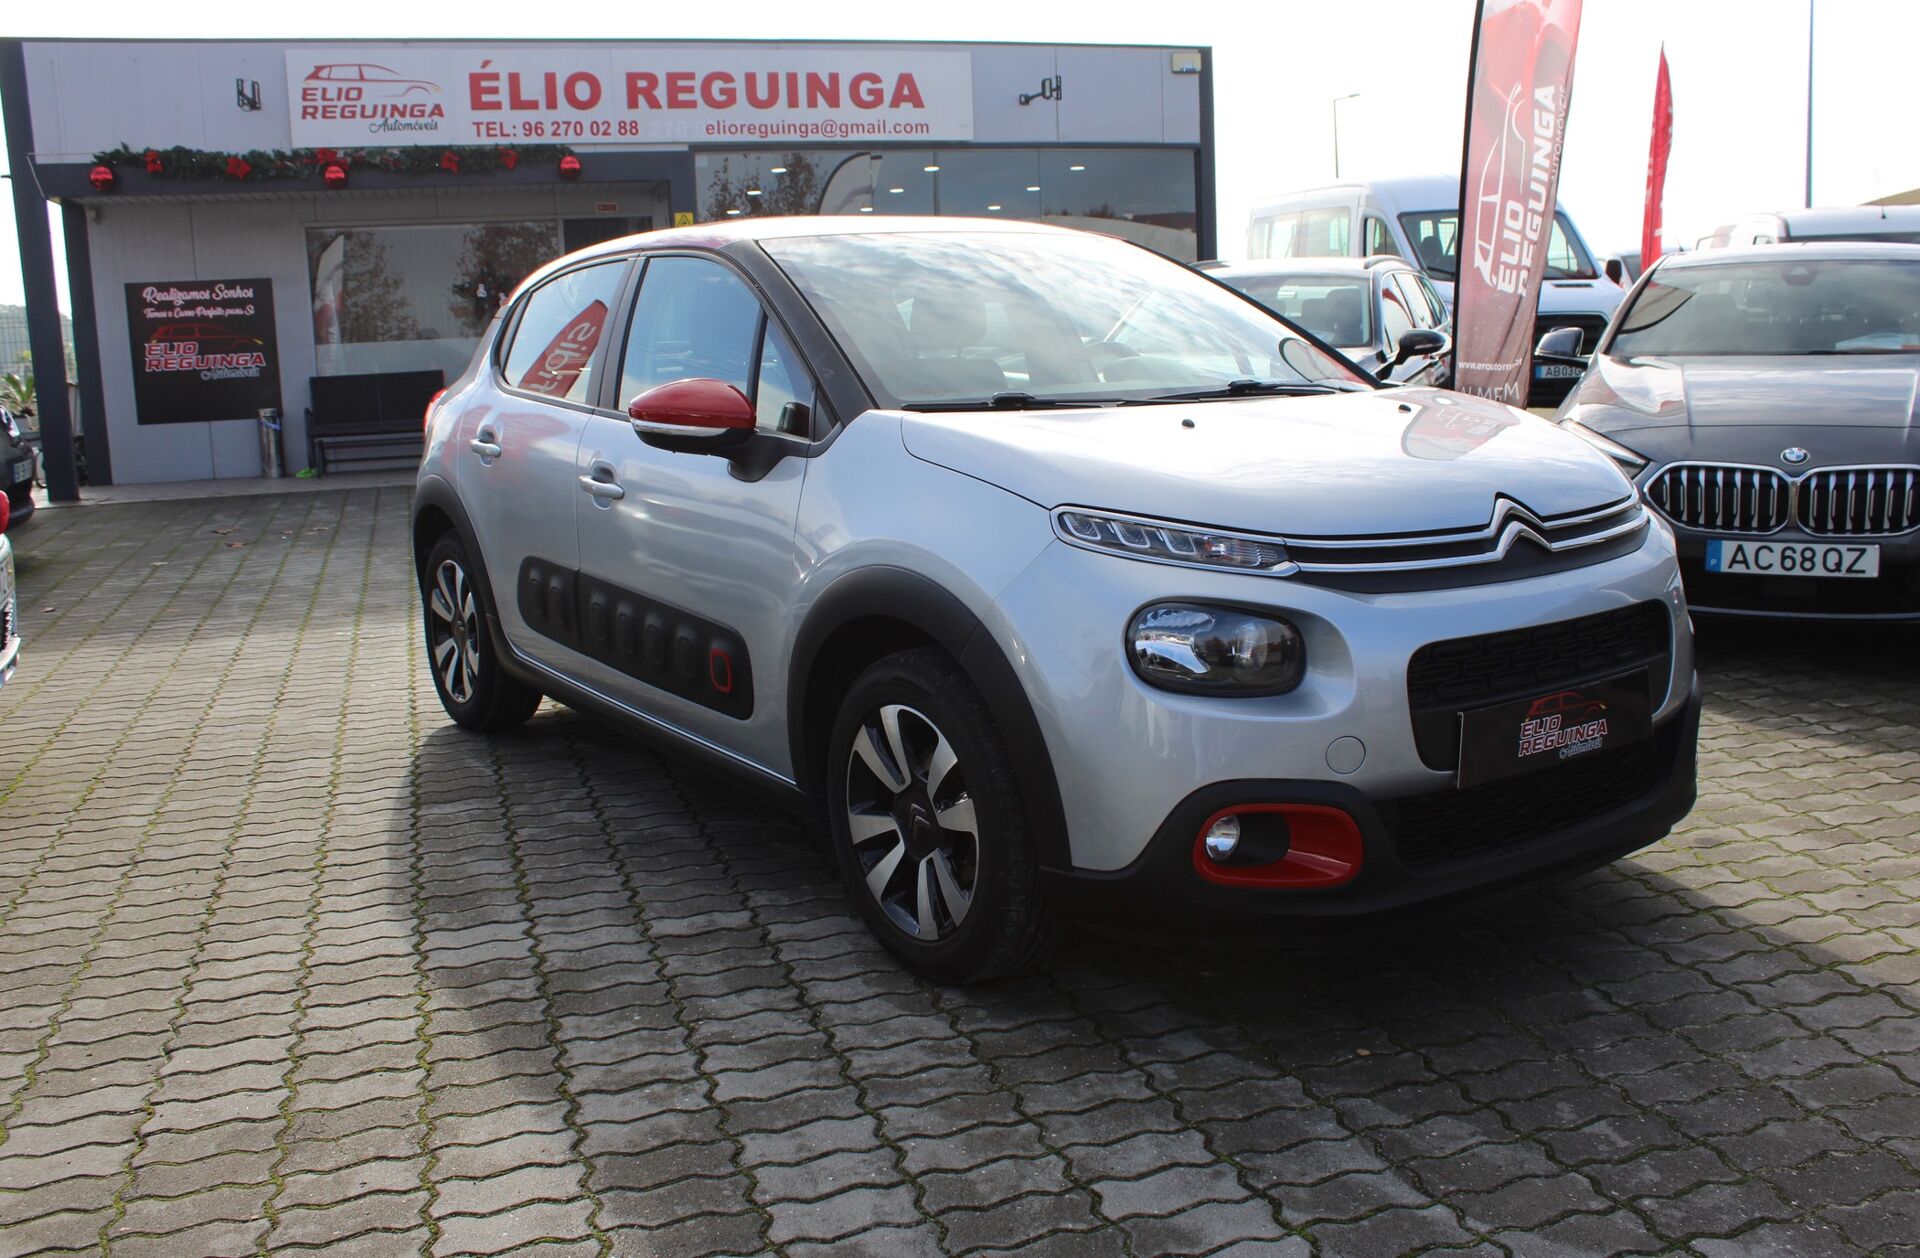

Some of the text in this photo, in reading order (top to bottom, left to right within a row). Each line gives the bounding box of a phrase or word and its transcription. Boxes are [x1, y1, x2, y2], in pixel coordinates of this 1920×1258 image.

[301, 87, 363, 101] ELIO
[469, 59, 925, 111] ÉLIO REGUINGA
[301, 103, 445, 120] REGUINGA
[369, 117, 439, 134] Automóveis
[472, 120, 639, 138] TEL: 96 270 02 88
[705, 119, 929, 138] elioreguinga@gmail.com
[142, 284, 253, 305] Realizamos Sonhos
[144, 341, 199, 358] ELIO
[145, 352, 266, 373] REGUINGA
[1545, 366, 1587, 377] AB03G
[1520, 714, 1562, 739] ELIO
[1518, 718, 1608, 757] REGUINGA
